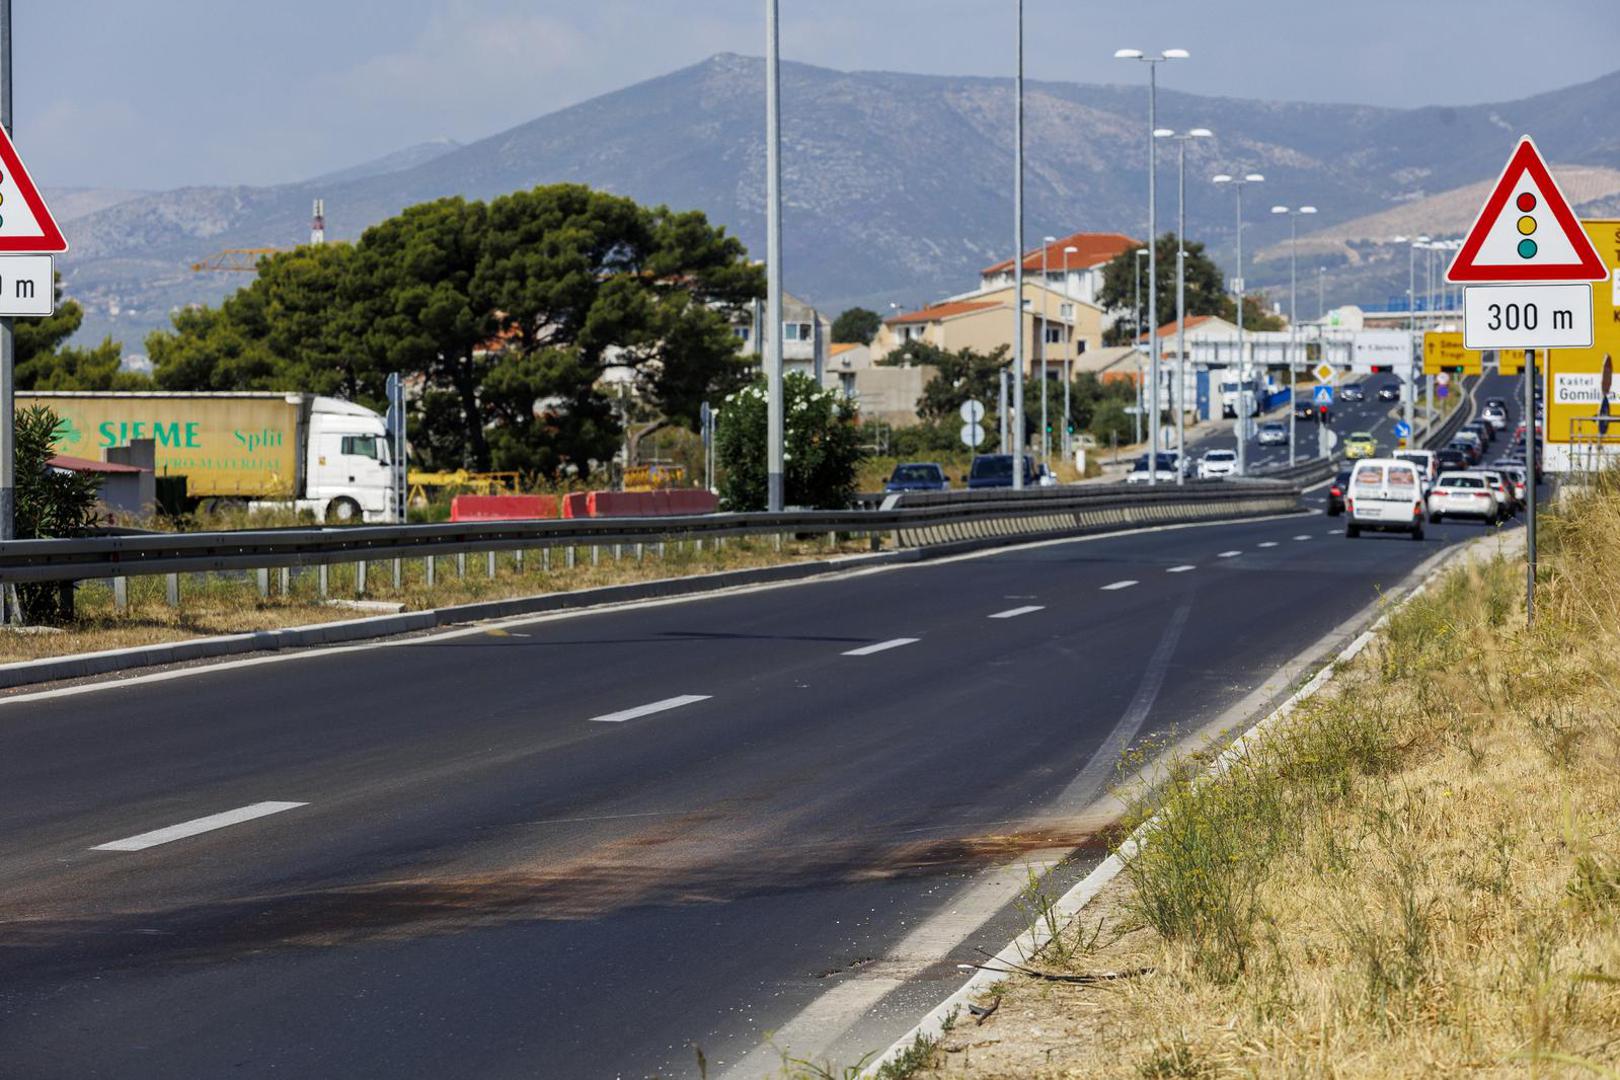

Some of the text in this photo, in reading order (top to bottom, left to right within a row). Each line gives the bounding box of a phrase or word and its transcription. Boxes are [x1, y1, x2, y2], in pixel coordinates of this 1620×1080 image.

[16, 279, 35, 298] m
[1488, 303, 1573, 331] 300 m
[1559, 387, 1616, 401] Gomilia
[231, 429, 284, 452] Split
